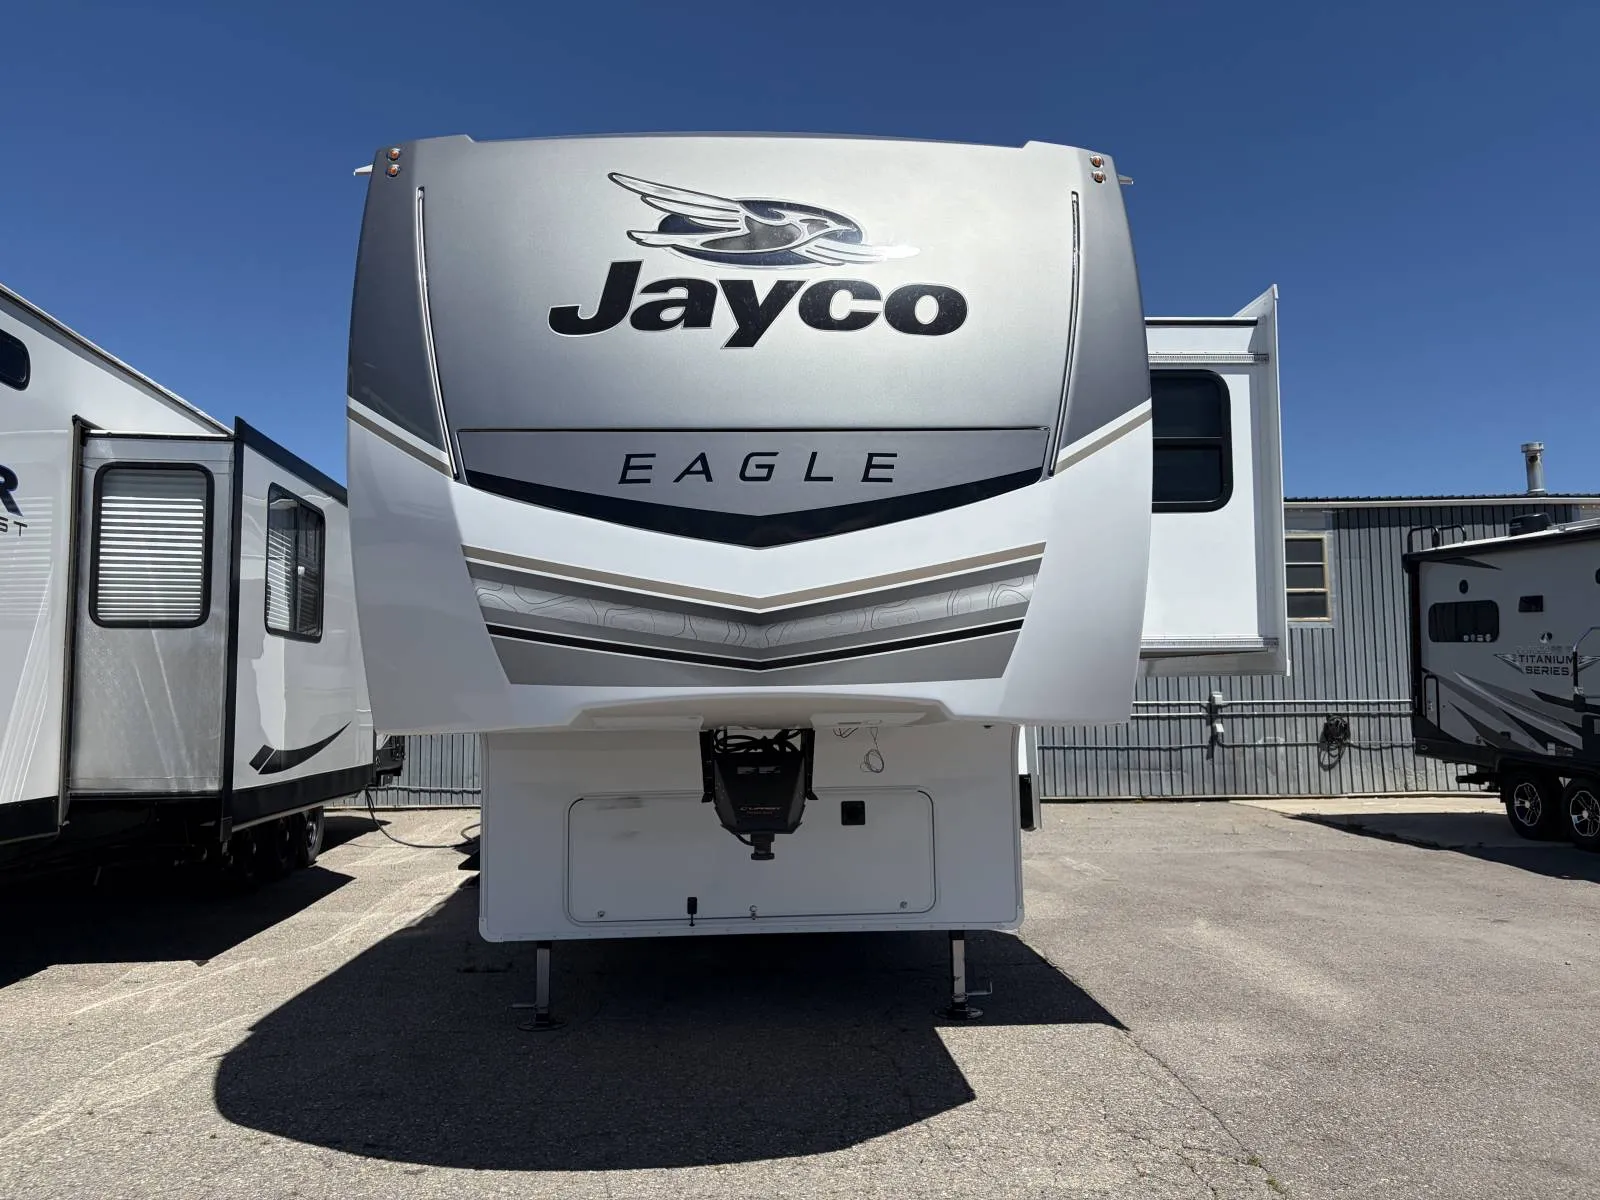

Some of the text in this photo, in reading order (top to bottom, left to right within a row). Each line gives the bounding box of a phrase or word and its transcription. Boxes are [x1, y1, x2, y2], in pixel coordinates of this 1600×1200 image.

[549, 260, 968, 348] Jayco
[618, 451, 898, 484] EAGLE
[1518, 654, 1574, 664] TITANIUM
[1525, 666, 1569, 675] SERIES
